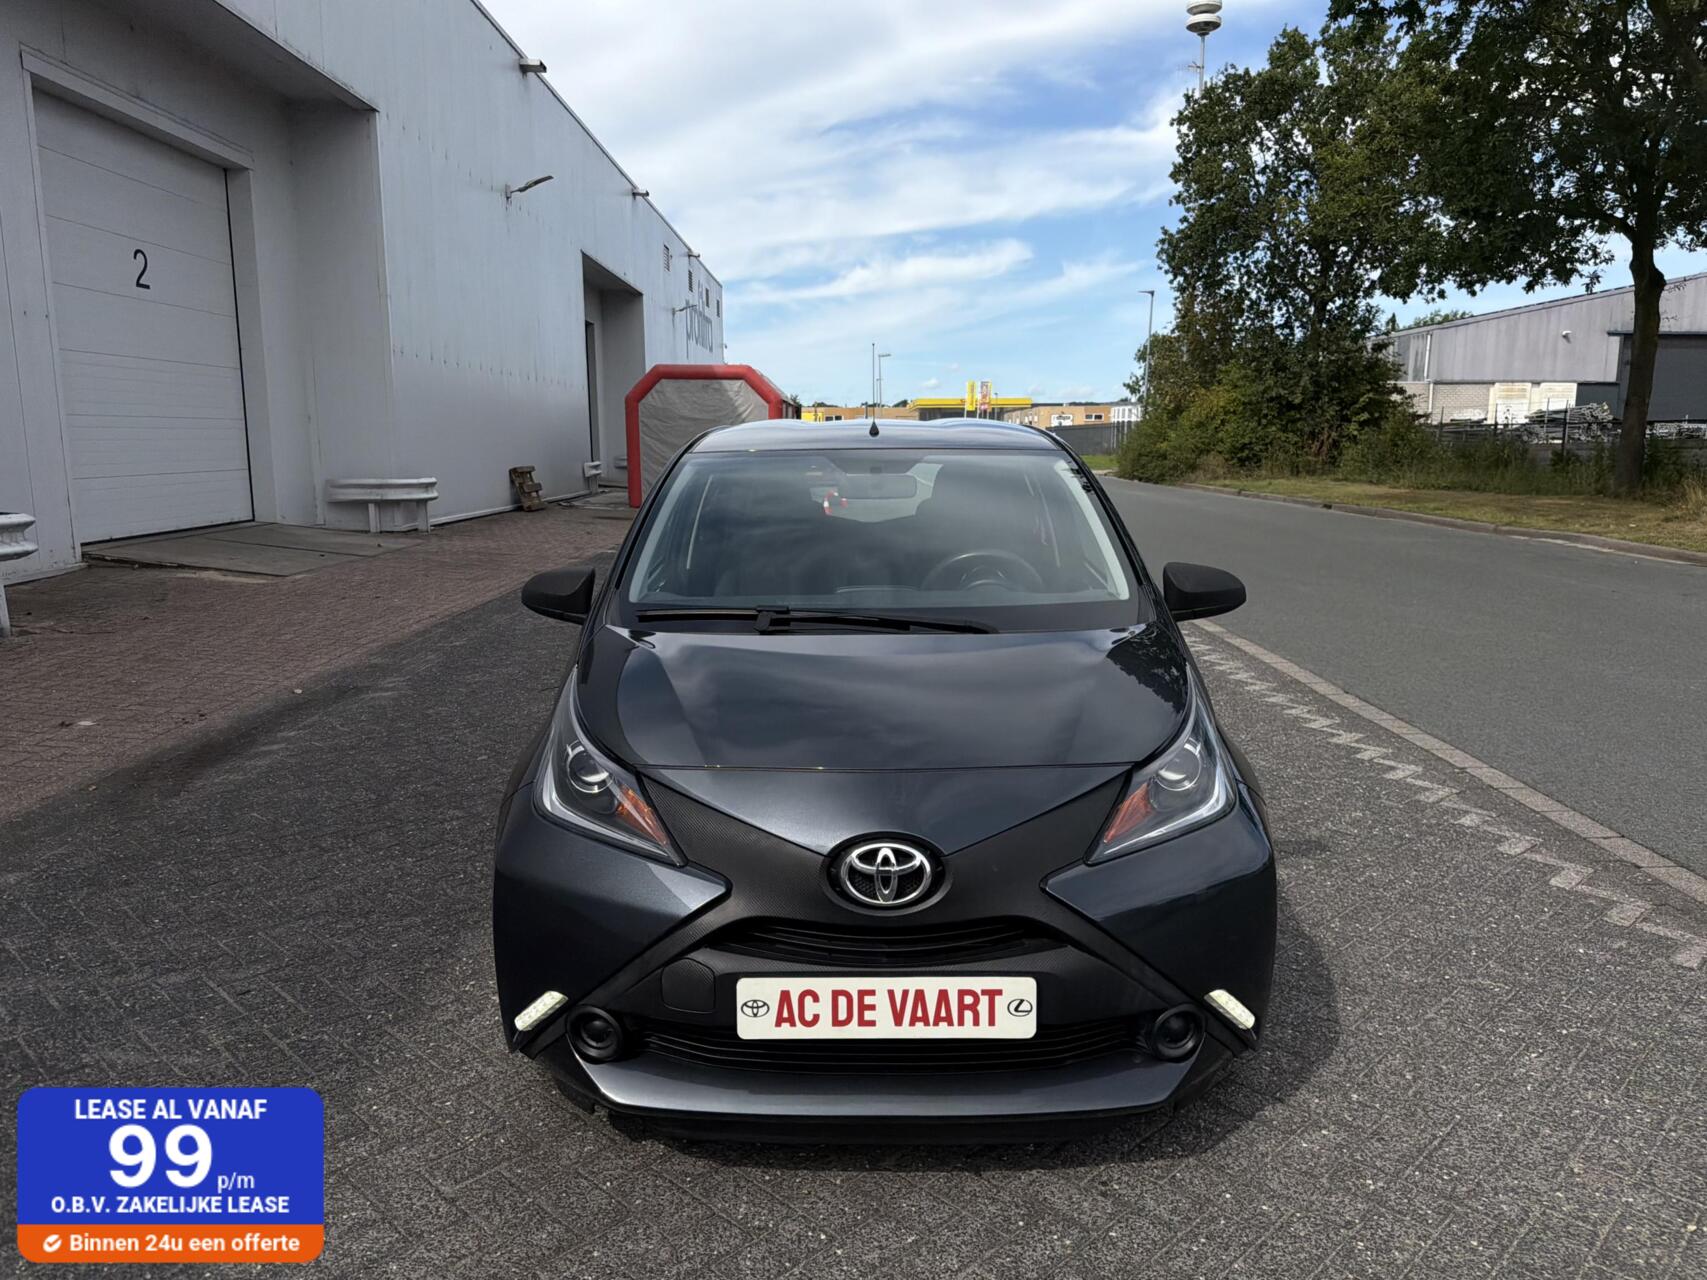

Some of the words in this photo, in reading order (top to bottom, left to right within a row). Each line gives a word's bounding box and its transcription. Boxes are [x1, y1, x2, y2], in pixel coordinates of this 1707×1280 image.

[134, 249, 150, 289] 2
[776, 989, 819, 1027] AC
[832, 989, 876, 1027] DE
[888, 989, 1002, 1027] VAART
